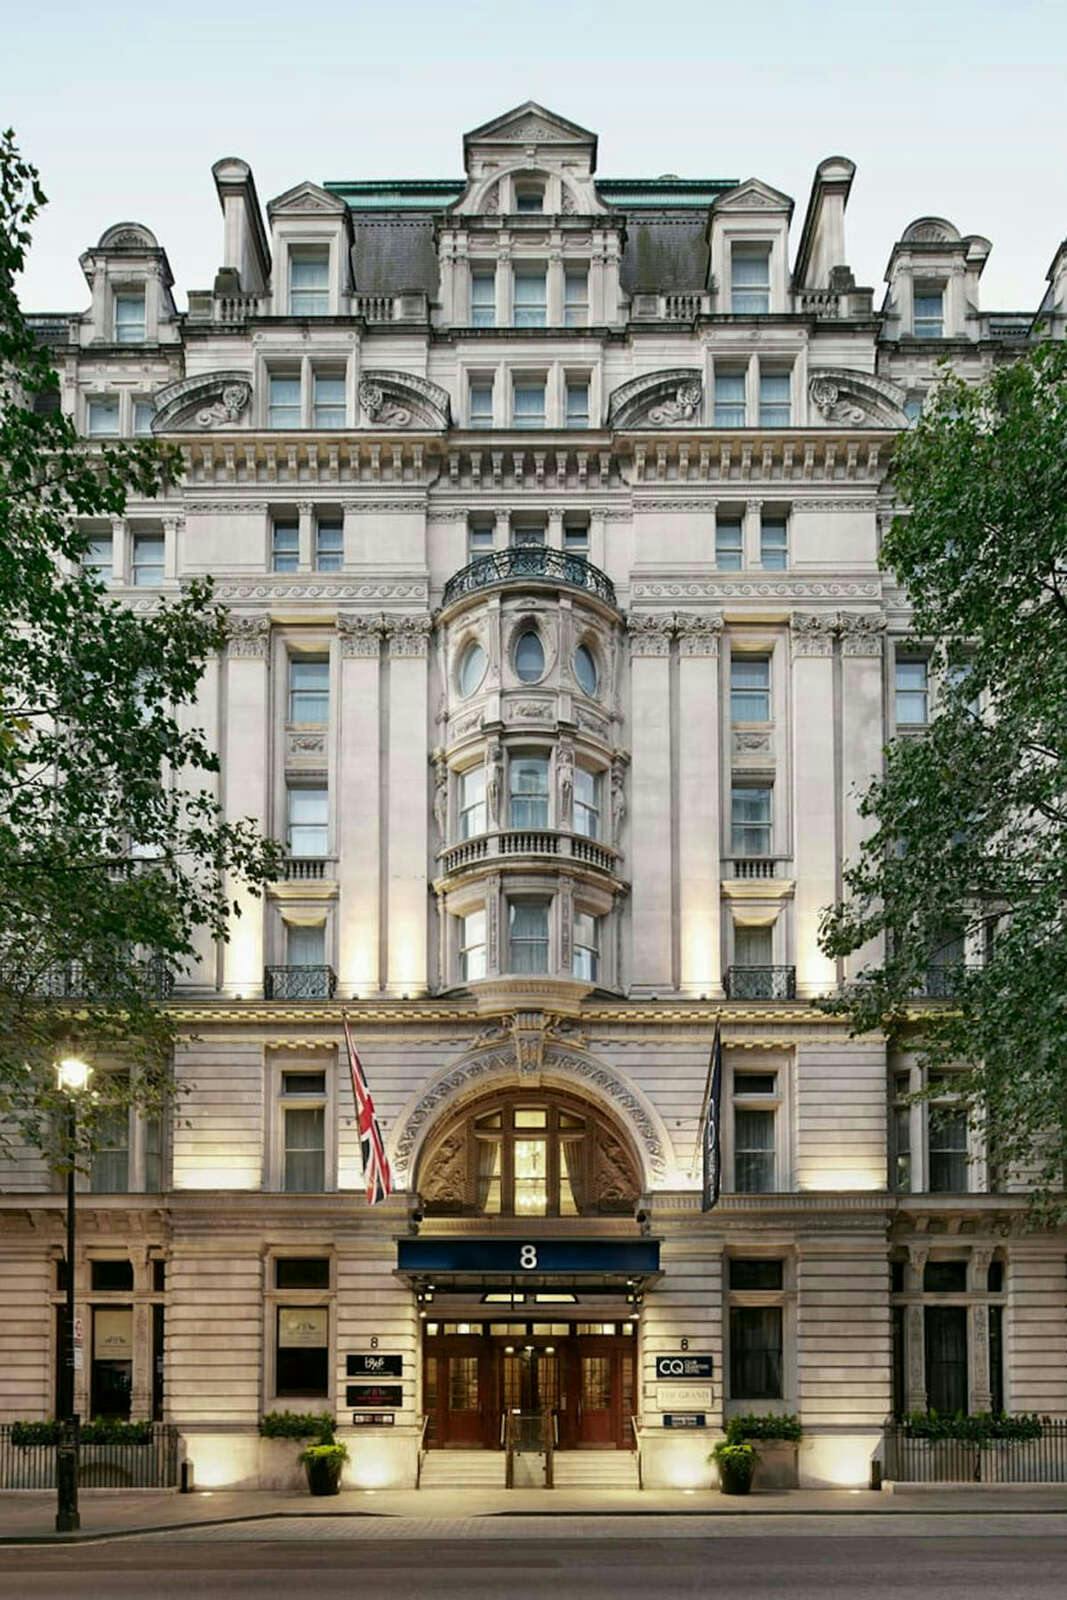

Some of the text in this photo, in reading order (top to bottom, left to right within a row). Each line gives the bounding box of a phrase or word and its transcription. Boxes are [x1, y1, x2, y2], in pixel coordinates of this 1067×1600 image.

[520, 1245, 537, 1269] 8
[370, 1336, 378, 1348] 8
[681, 1338, 688, 1351] 8
[660, 1360, 684, 1374] CQ
